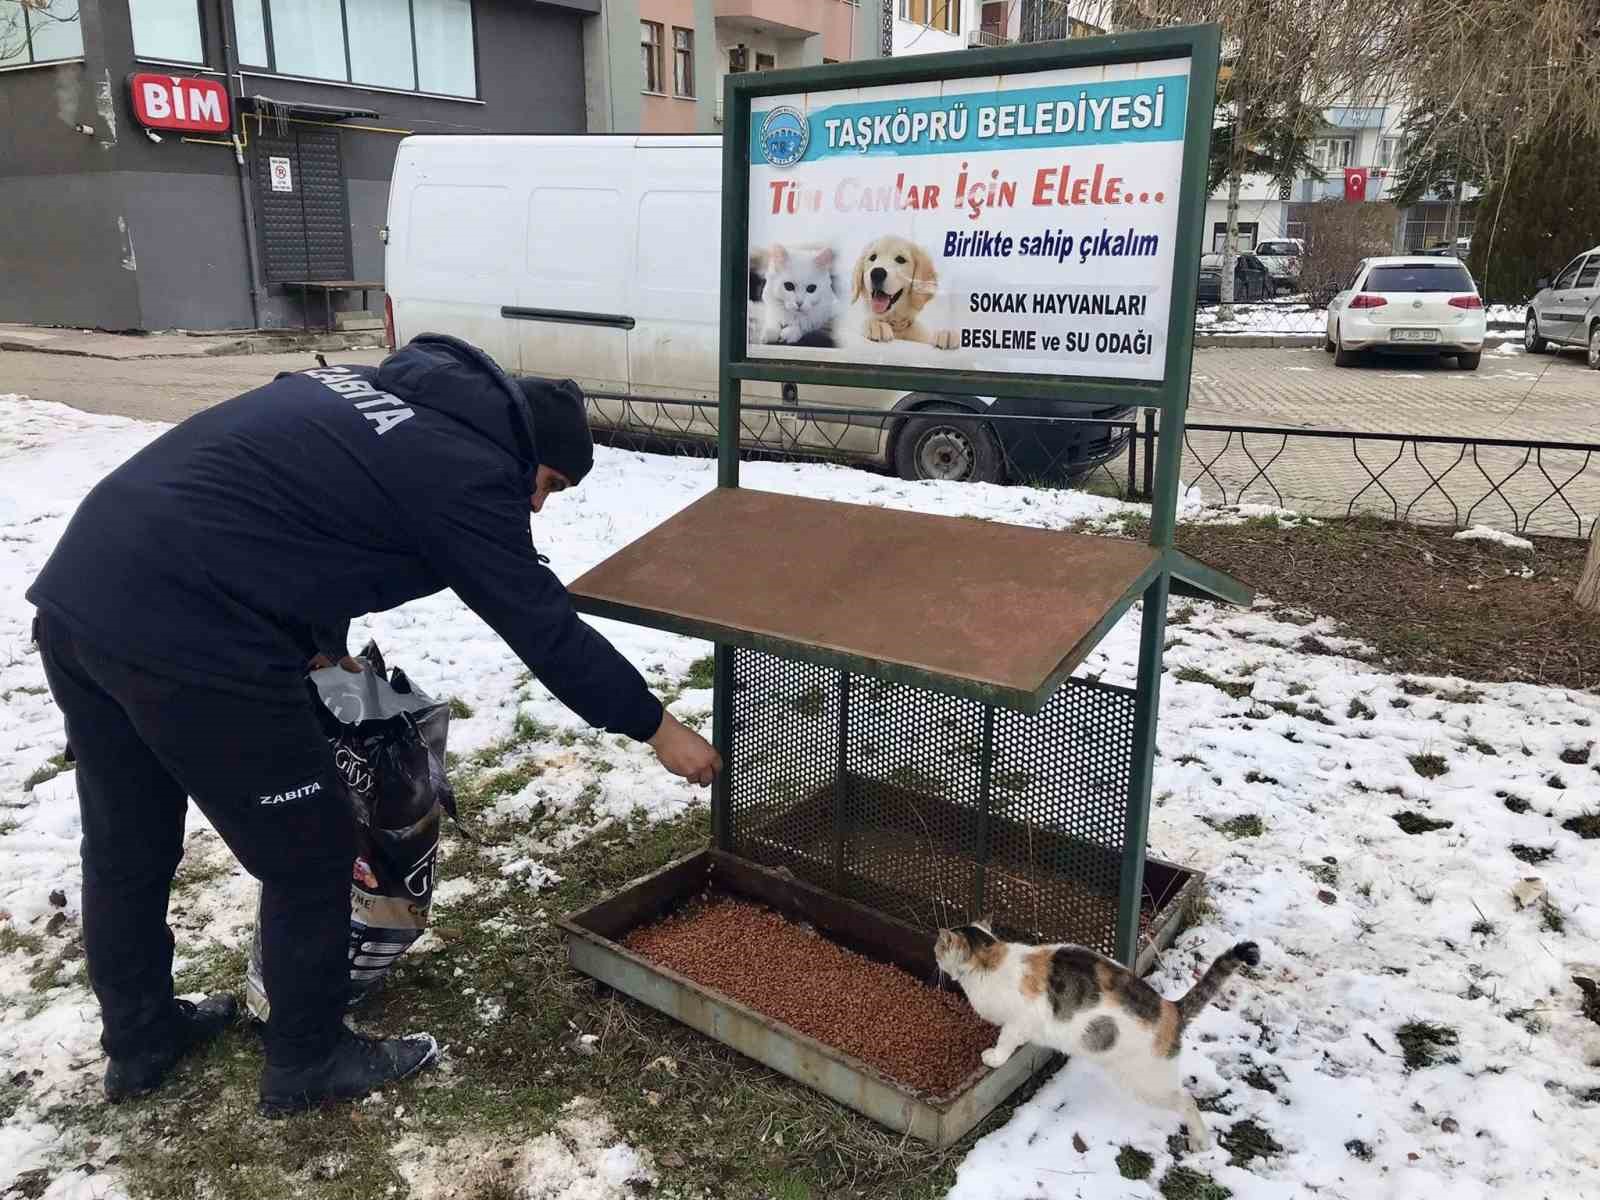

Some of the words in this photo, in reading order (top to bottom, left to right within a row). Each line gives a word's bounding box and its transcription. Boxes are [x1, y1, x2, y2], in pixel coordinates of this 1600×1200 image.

[142, 76, 223, 123] BİM
[825, 103, 968, 153] TAŞKÖPRÜ
[977, 85, 1166, 138] BELEDİYESİ
[943, 230, 1013, 258] Birlikte
[1018, 229, 1074, 264] sahip
[1079, 228, 1160, 264] çıkalım
[969, 292, 1028, 314] SOKAK
[1032, 293, 1147, 316] HAYVANLARI
[961, 328, 1037, 351] BESLEME
[1041, 336, 1061, 351] ve
[1066, 331, 1090, 352] SU
[1095, 329, 1153, 356] ODAĞI
[259, 782, 322, 805] ZABITA
